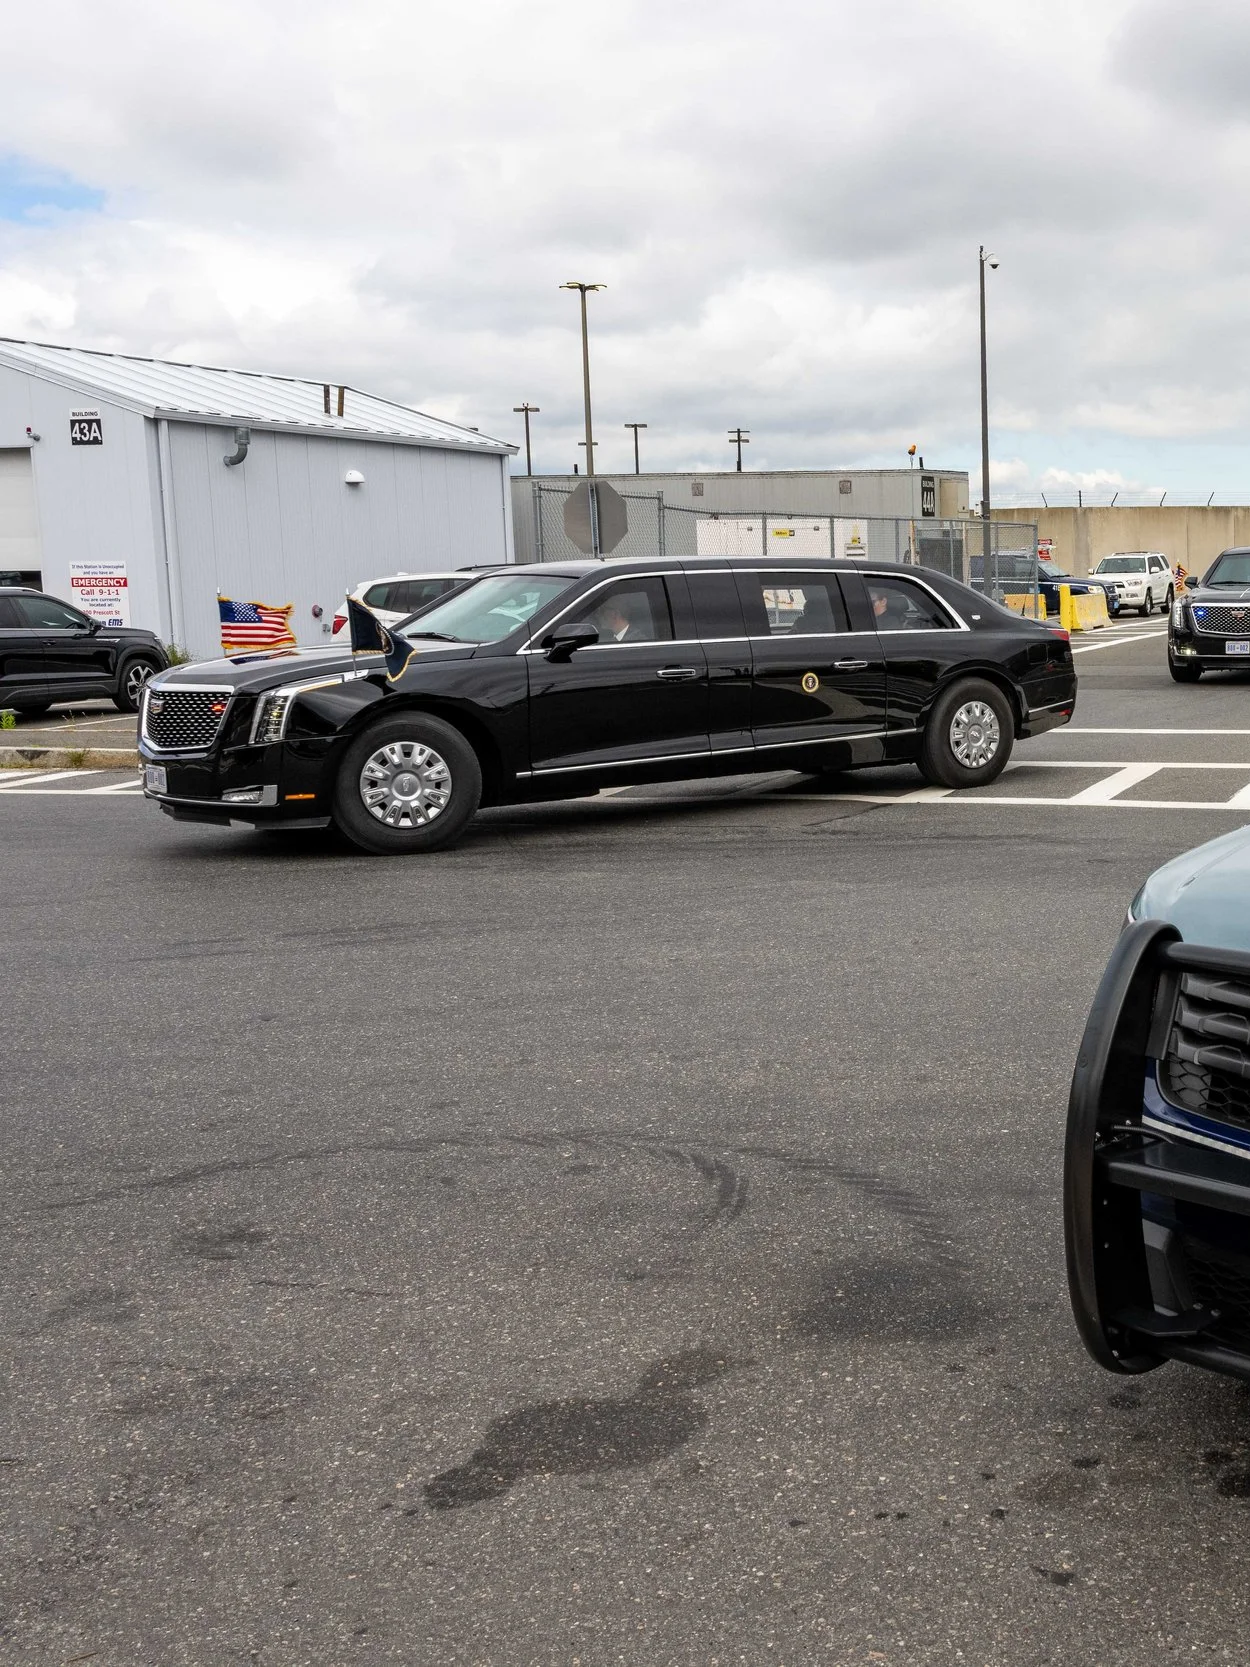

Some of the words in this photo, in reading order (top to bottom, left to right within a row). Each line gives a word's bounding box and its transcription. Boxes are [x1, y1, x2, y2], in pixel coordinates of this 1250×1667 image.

[71, 422, 102, 441] 43A
[922, 491, 935, 512] 44A
[73, 578, 126, 586] EMERGENCY
